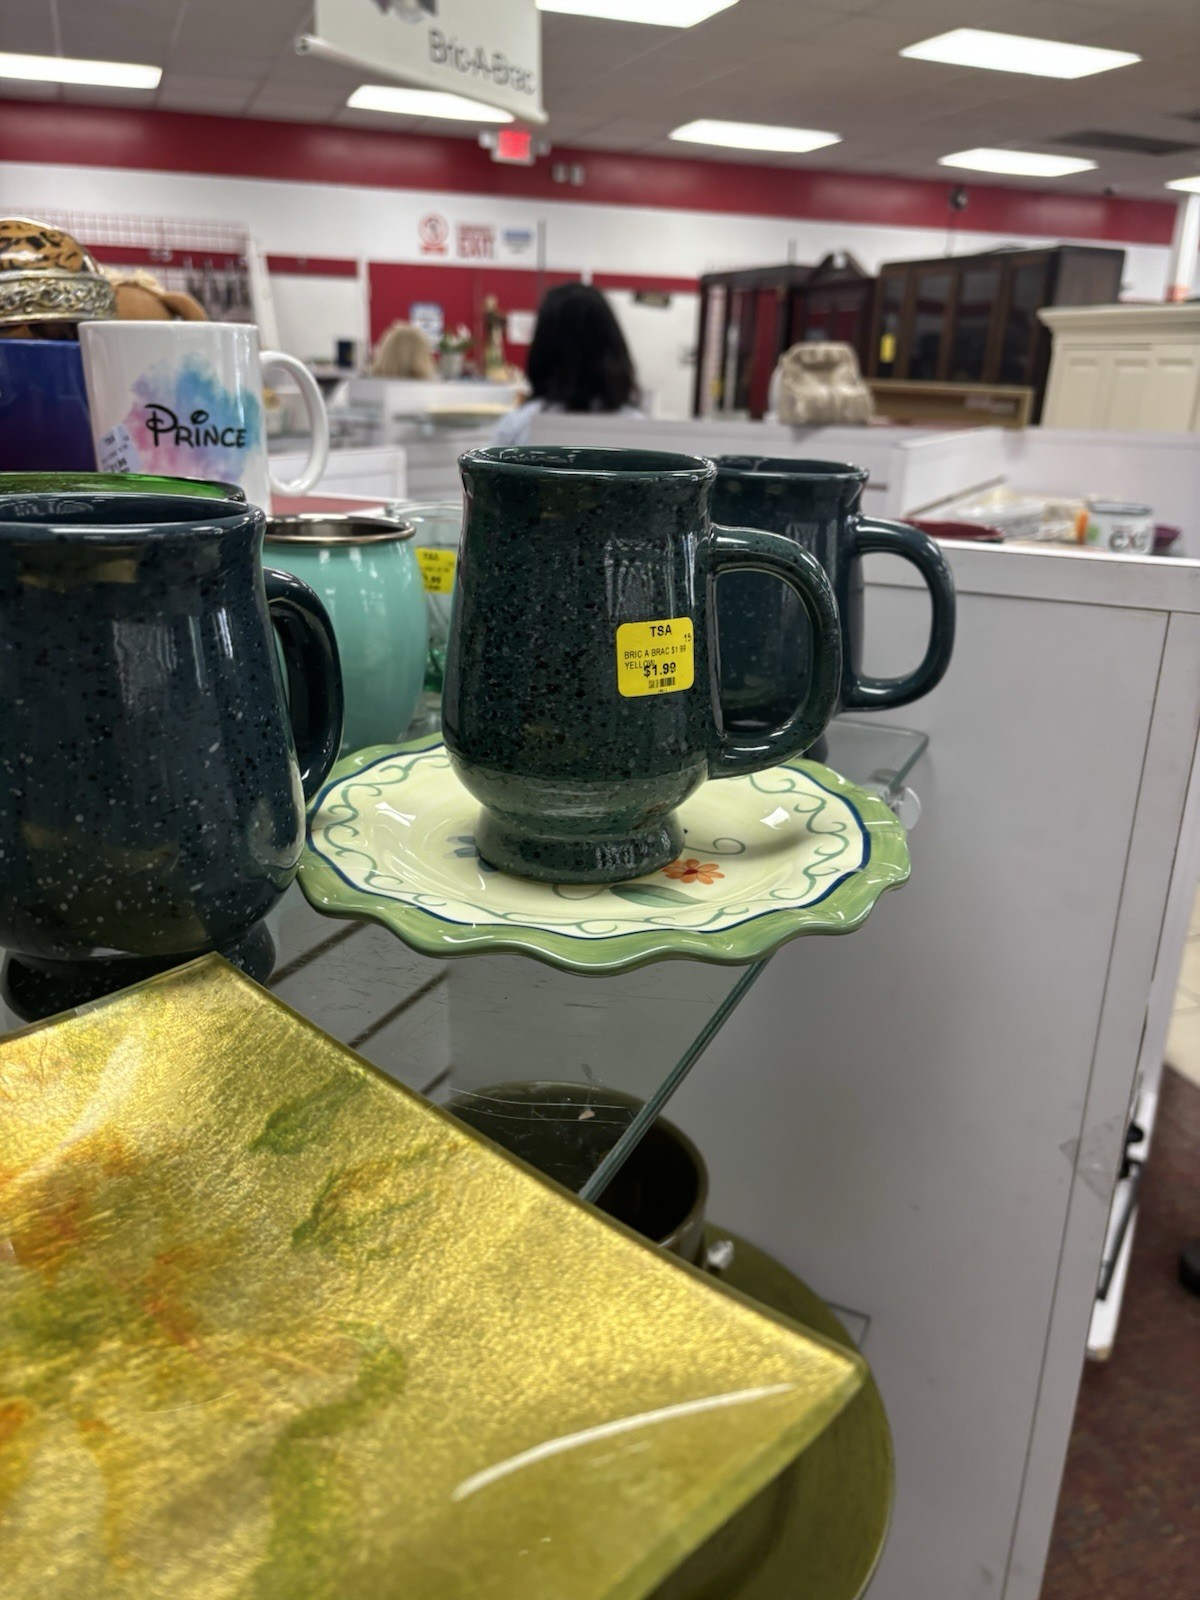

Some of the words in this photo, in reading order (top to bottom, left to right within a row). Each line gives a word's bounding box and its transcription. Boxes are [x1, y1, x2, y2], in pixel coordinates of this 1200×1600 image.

[650, 625, 672, 637] TSA
[624, 650, 642, 660] BRIC
[644, 650, 649, 658] A
[651, 647, 669, 657] BRAC
[624, 660, 655, 670] YELLOW
[644, 662, 676, 678] $1.99
